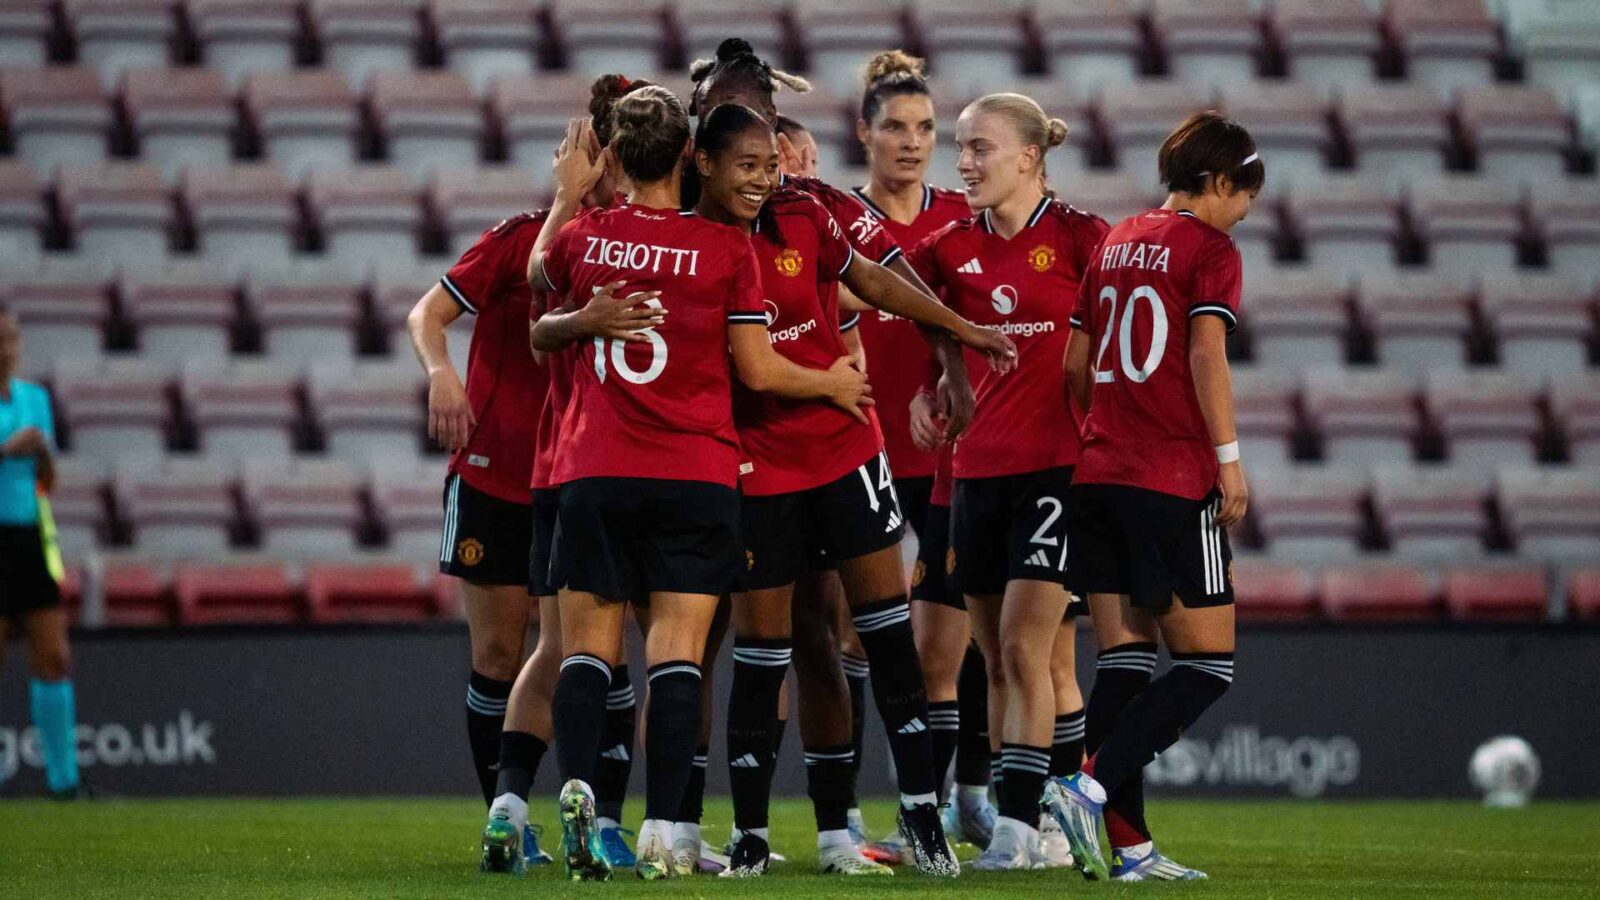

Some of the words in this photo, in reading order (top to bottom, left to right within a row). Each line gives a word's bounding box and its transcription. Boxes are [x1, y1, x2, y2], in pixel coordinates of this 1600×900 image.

[583, 236, 699, 276] ZIGIOTTI
[1101, 242, 1171, 273] HINATA
[1095, 285, 1168, 383] 20
[858, 450, 896, 513] 14
[1029, 496, 1063, 547] 2
